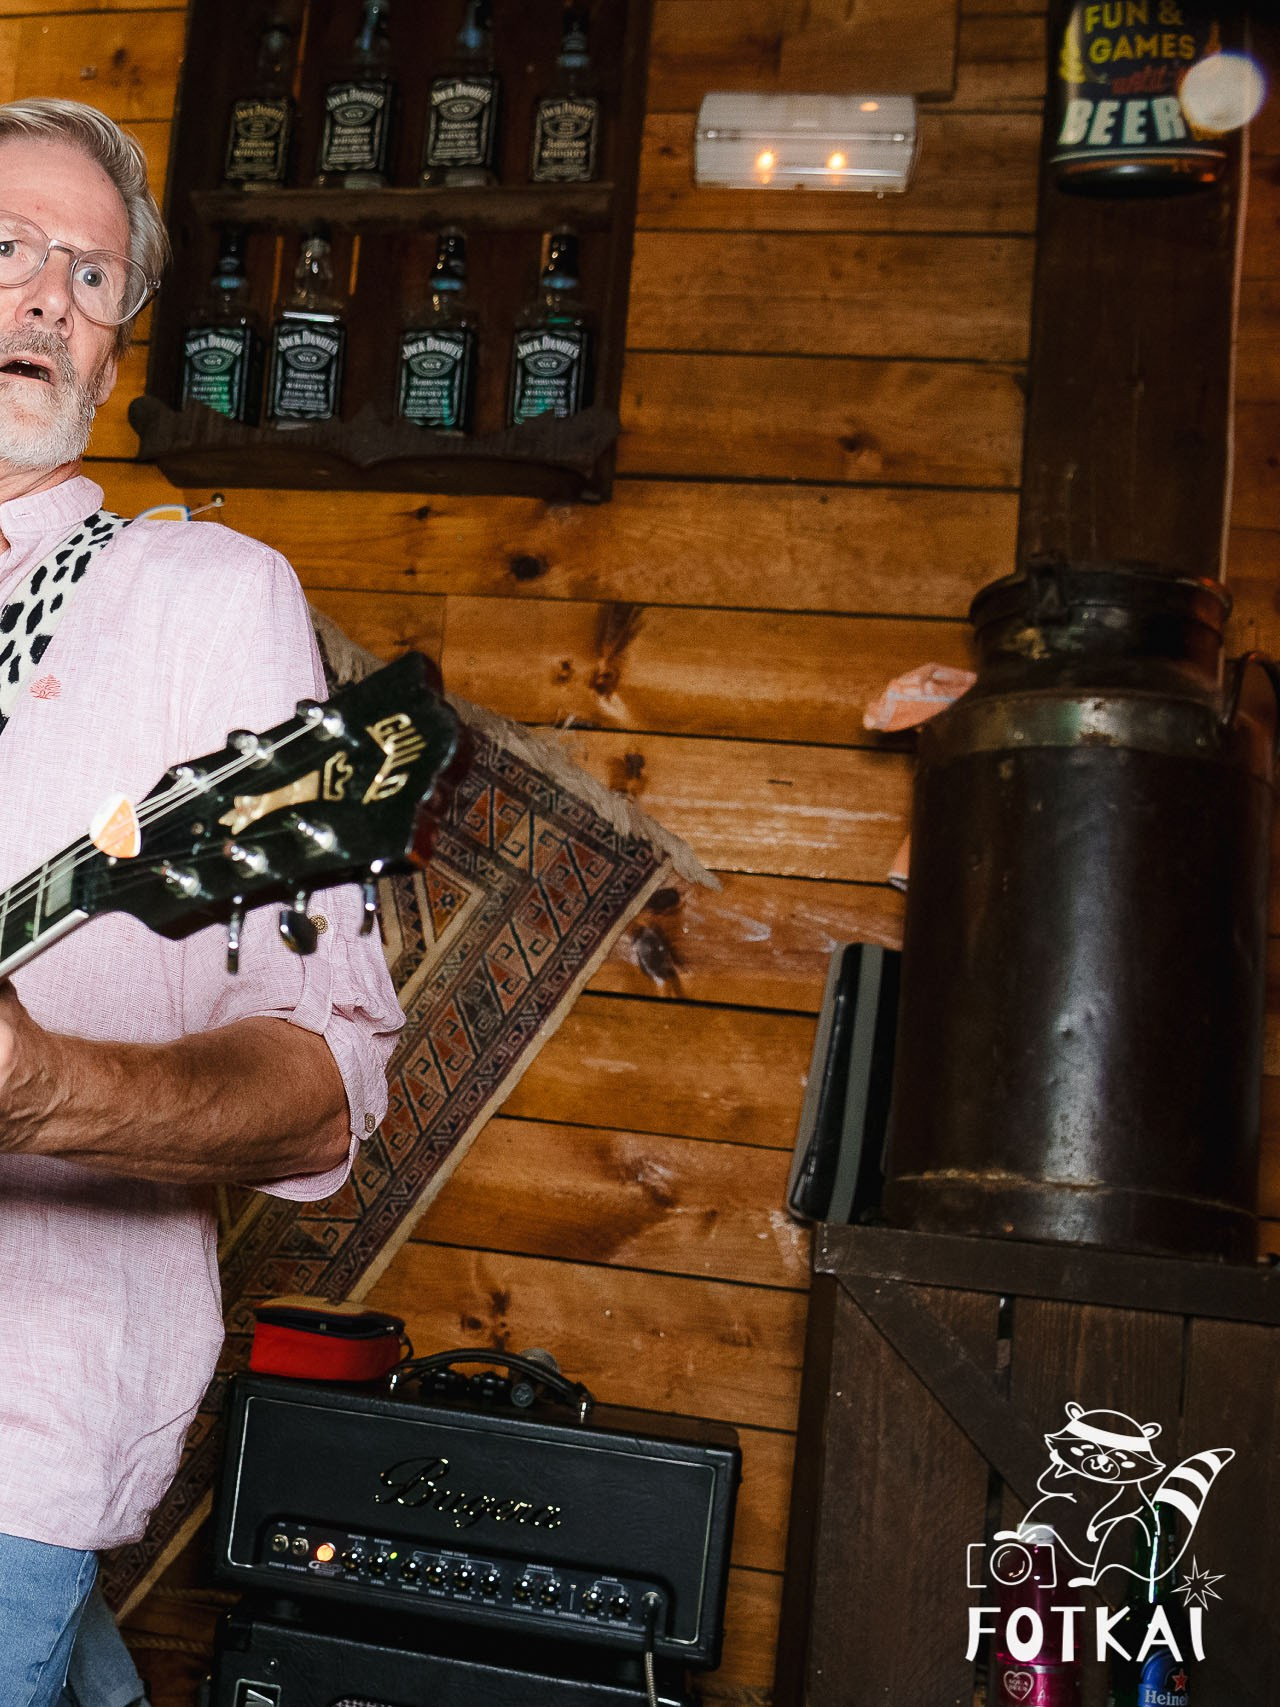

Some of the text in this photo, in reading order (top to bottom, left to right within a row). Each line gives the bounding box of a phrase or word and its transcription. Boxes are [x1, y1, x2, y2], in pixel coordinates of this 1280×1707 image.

[1085, 0, 1182, 32] FUN &
[1089, 34, 1195, 63] GAMES
[1056, 96, 1187, 146] BEER
[373, 1456, 563, 1530] Bugera
